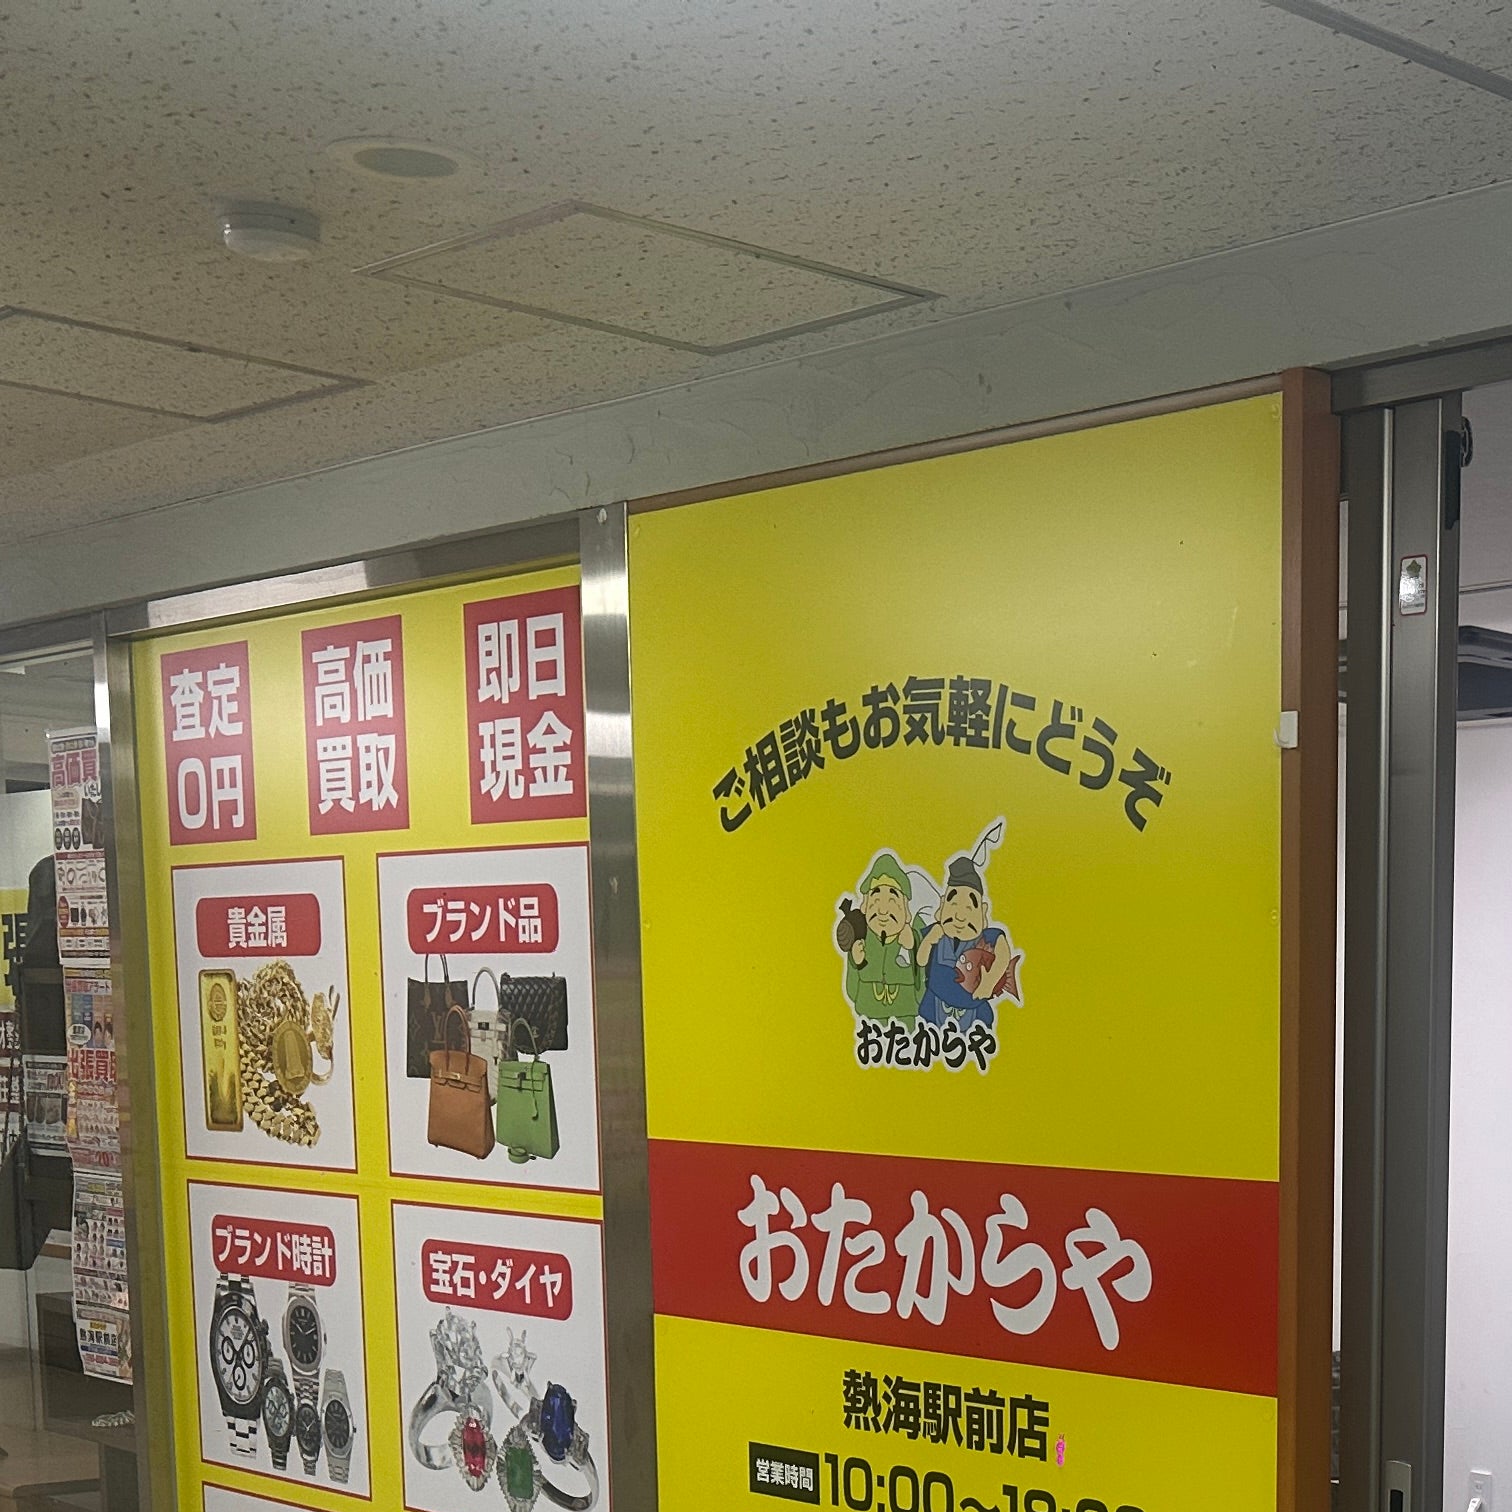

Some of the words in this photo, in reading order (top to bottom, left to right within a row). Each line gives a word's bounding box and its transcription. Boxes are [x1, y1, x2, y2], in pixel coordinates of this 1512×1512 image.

[311, 638, 395, 727] 高価
[477, 613, 567, 705] 即日
[169, 662, 245, 742] 査定
[316, 732, 400, 816] 買取
[478, 710, 575, 802] 現金
[712, 675, 1172, 832] ご相談もお気軽にどうぞ
[226, 906, 289, 950] 貴金属
[422, 896, 544, 945] ブランド品
[856, 1019, 997, 1071] おたからや
[215, 1225, 333, 1279] ブランド時計
[428, 1250, 564, 1308] 宝石・ダイヤ
[737, 1174, 1153, 1351] おたからや
[841, 1368, 1050, 1463] 熱海駅前店
[755, 1458, 815, 1493] 営業時間
